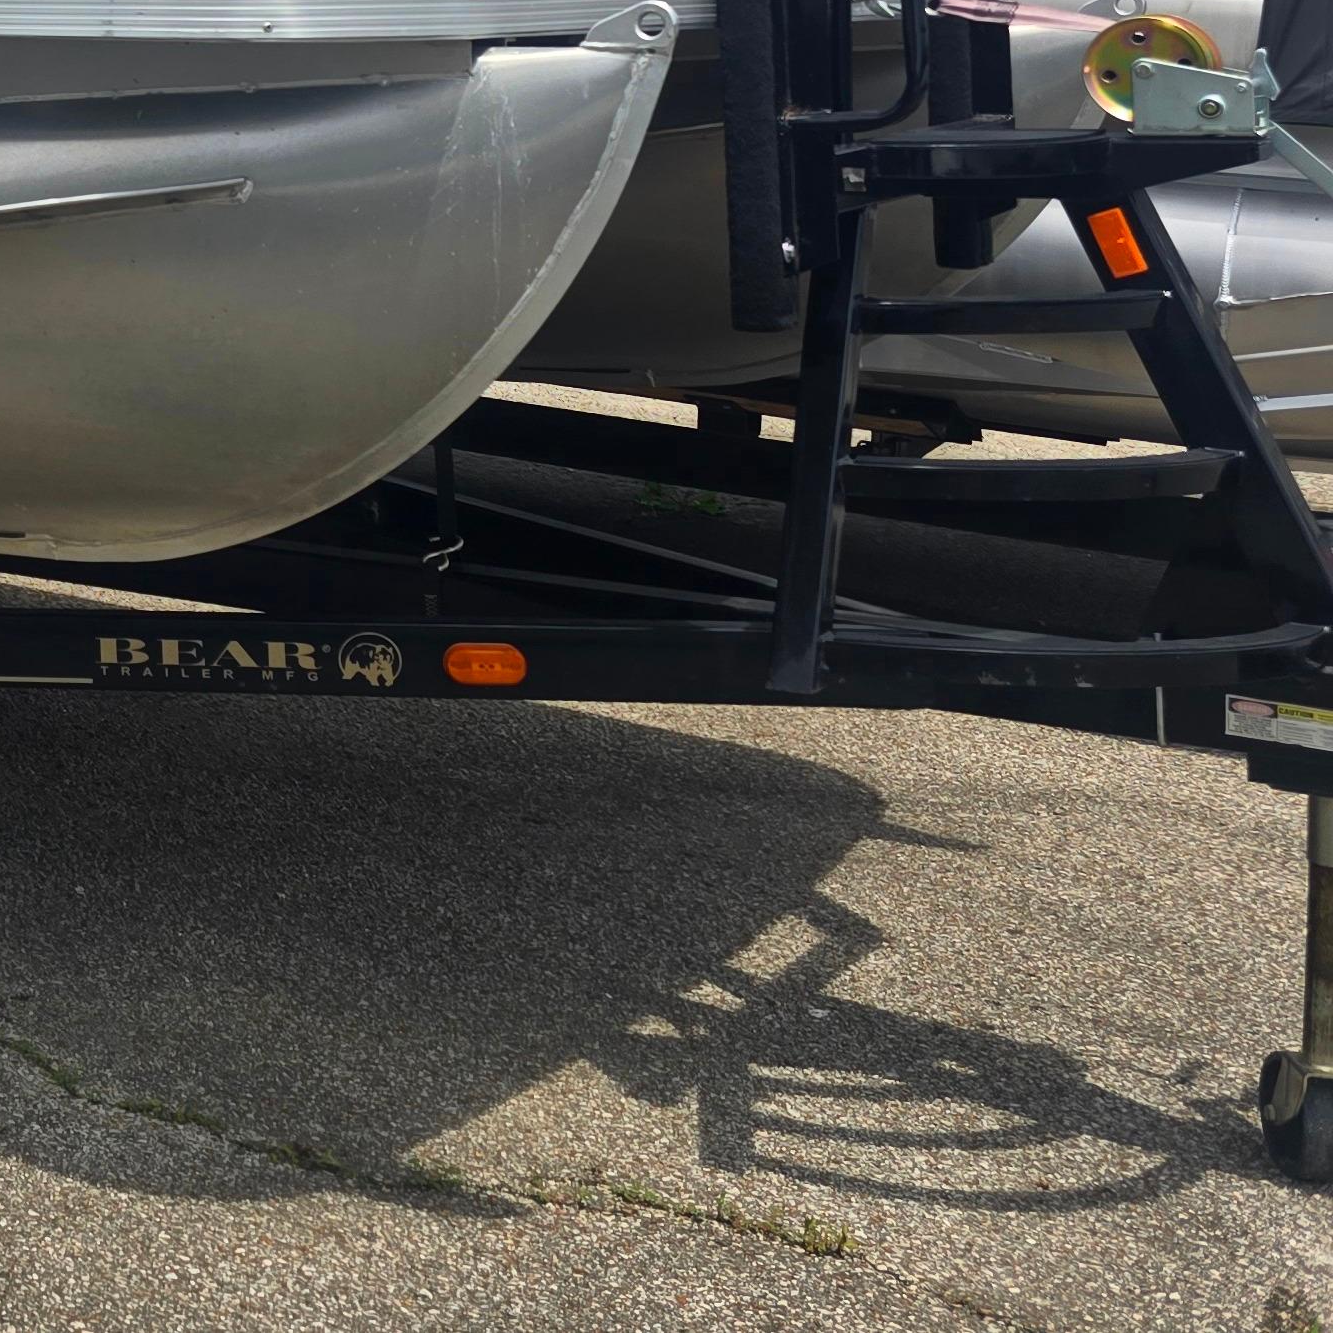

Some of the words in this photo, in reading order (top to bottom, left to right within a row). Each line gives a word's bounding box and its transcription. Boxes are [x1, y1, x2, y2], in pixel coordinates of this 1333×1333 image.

[94, 637, 322, 670] BEAR
[100, 666, 234, 680] TRAILER
[262, 669, 319, 682] MFG
